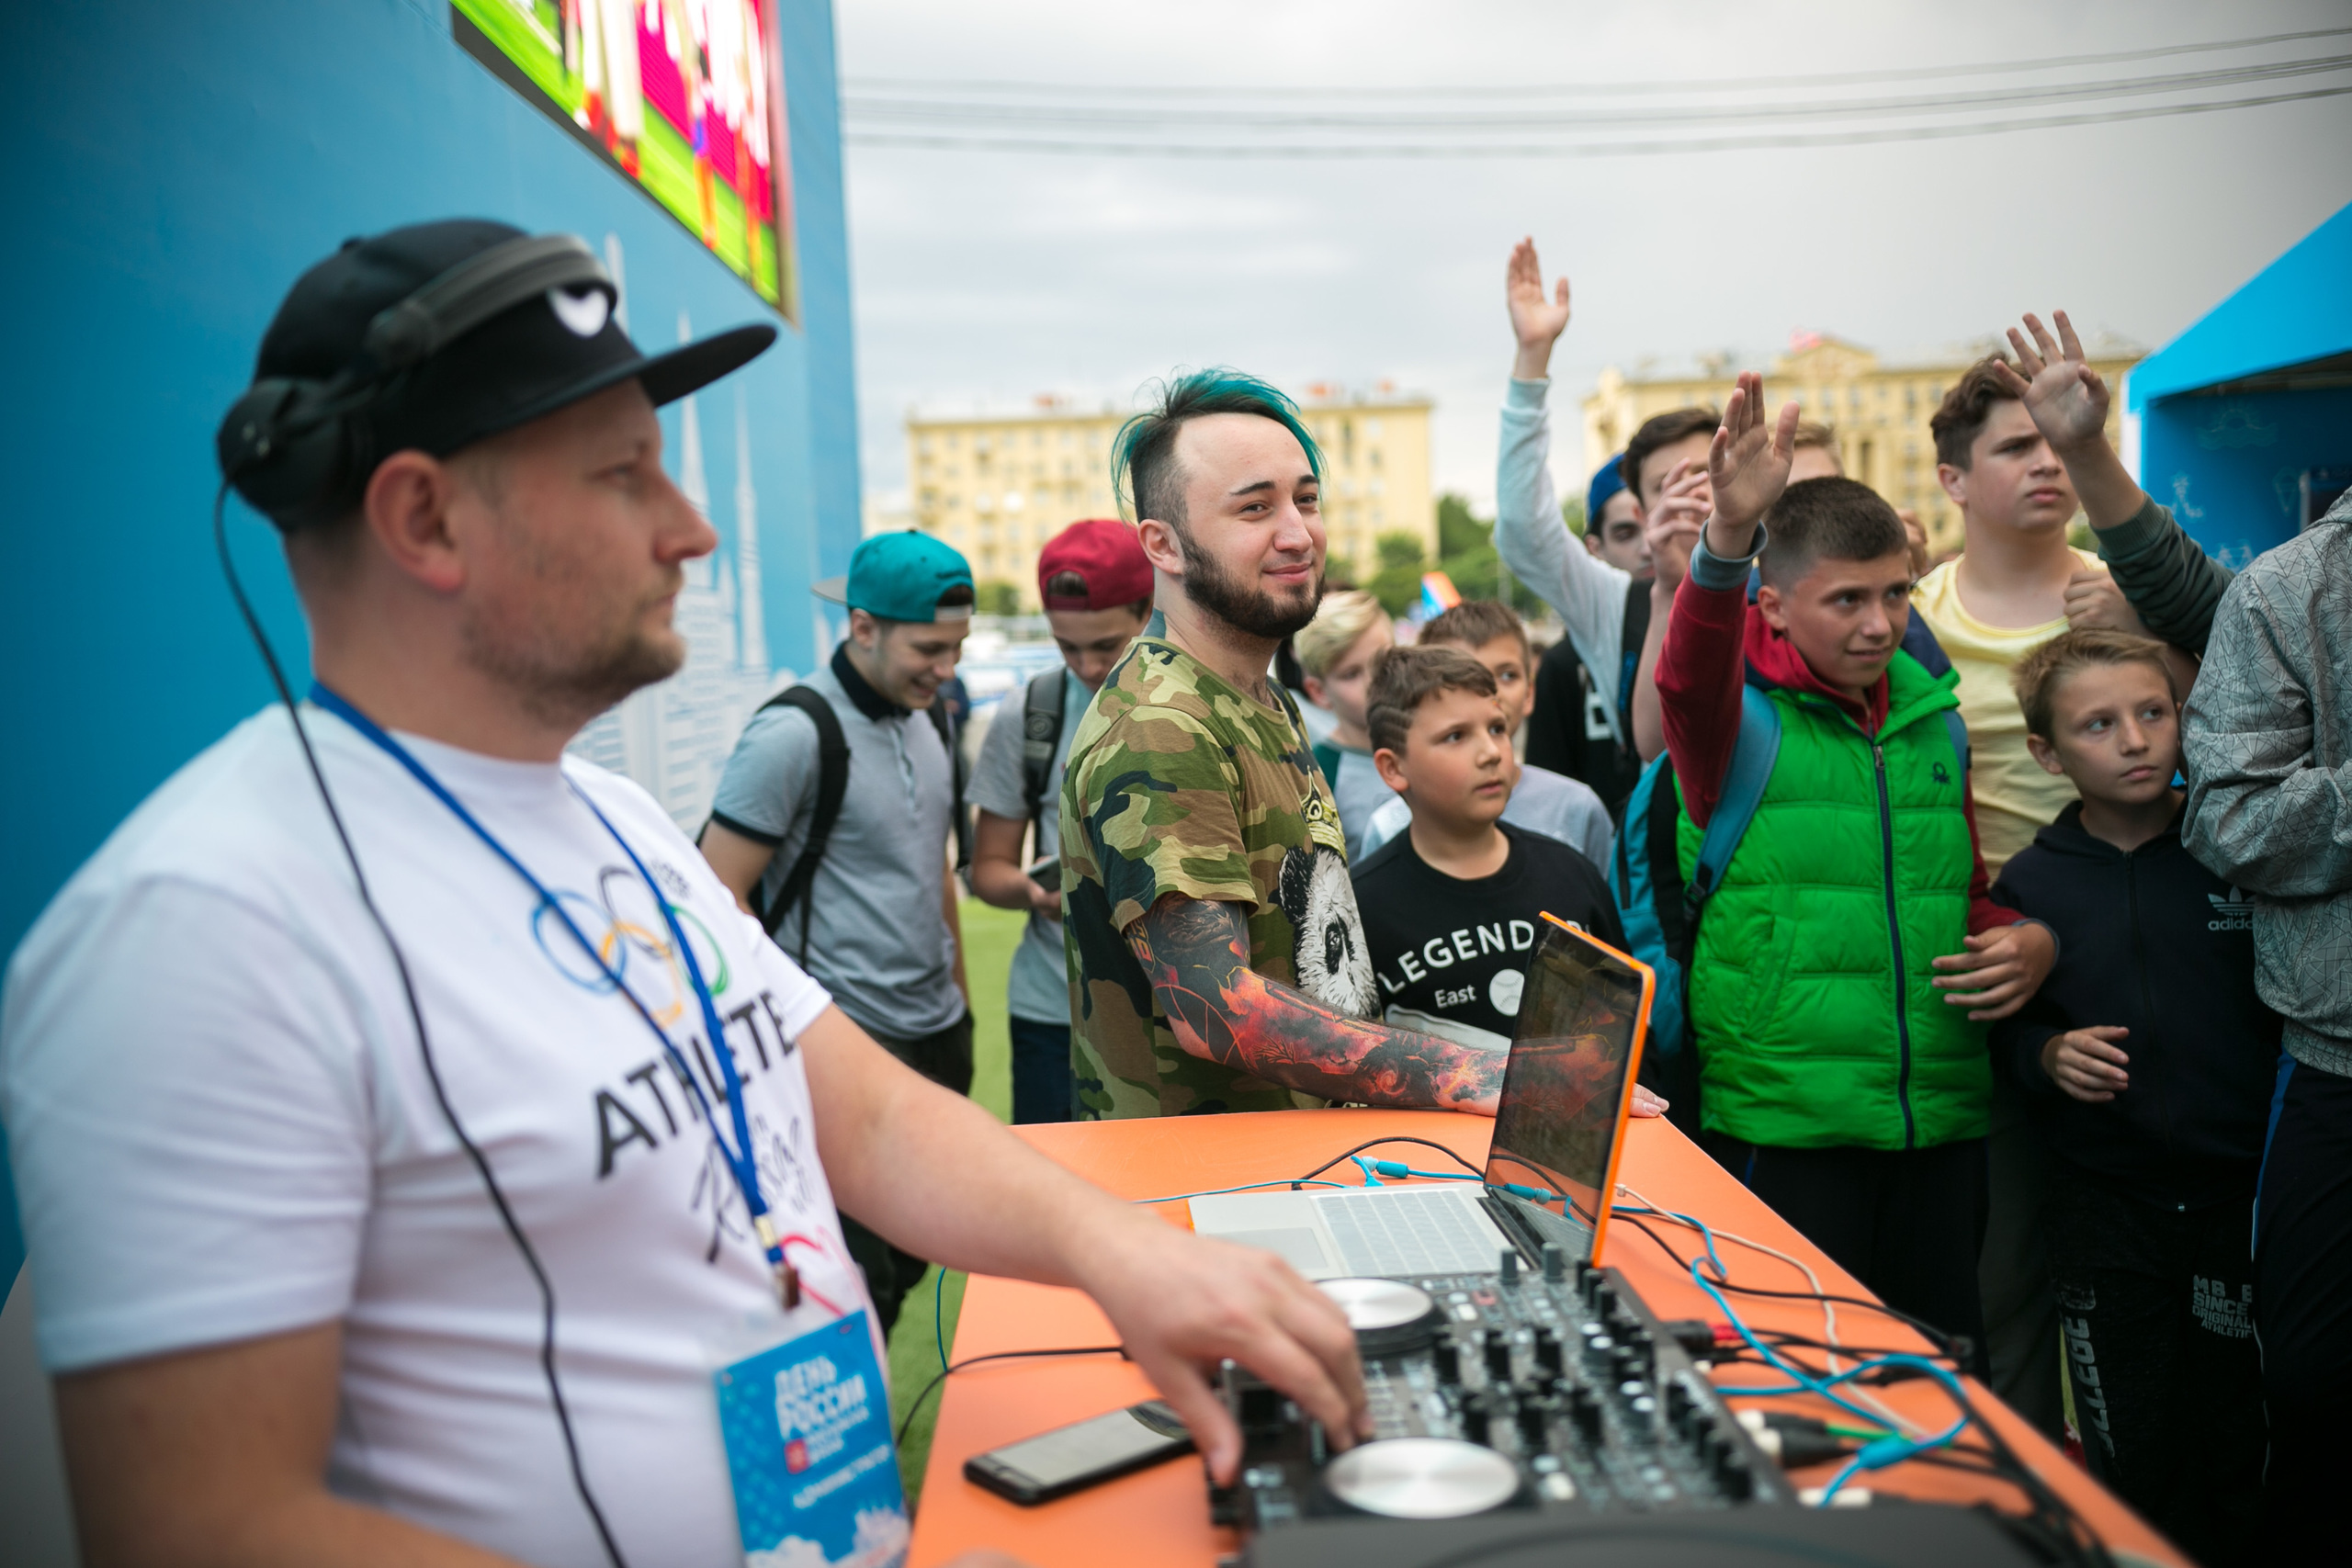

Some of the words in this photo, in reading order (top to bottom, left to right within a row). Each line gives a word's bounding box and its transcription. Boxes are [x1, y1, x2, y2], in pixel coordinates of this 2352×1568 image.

[2207, 917, 2253, 931] adida
[1377, 919, 1590, 994] LEGEND
[1434, 984, 1477, 1009] East
[2193, 1292, 2248, 1315] SINCE
[2192, 1304, 2252, 1329] ORIGINAL
[775, 1374, 868, 1440] РОССИИ
